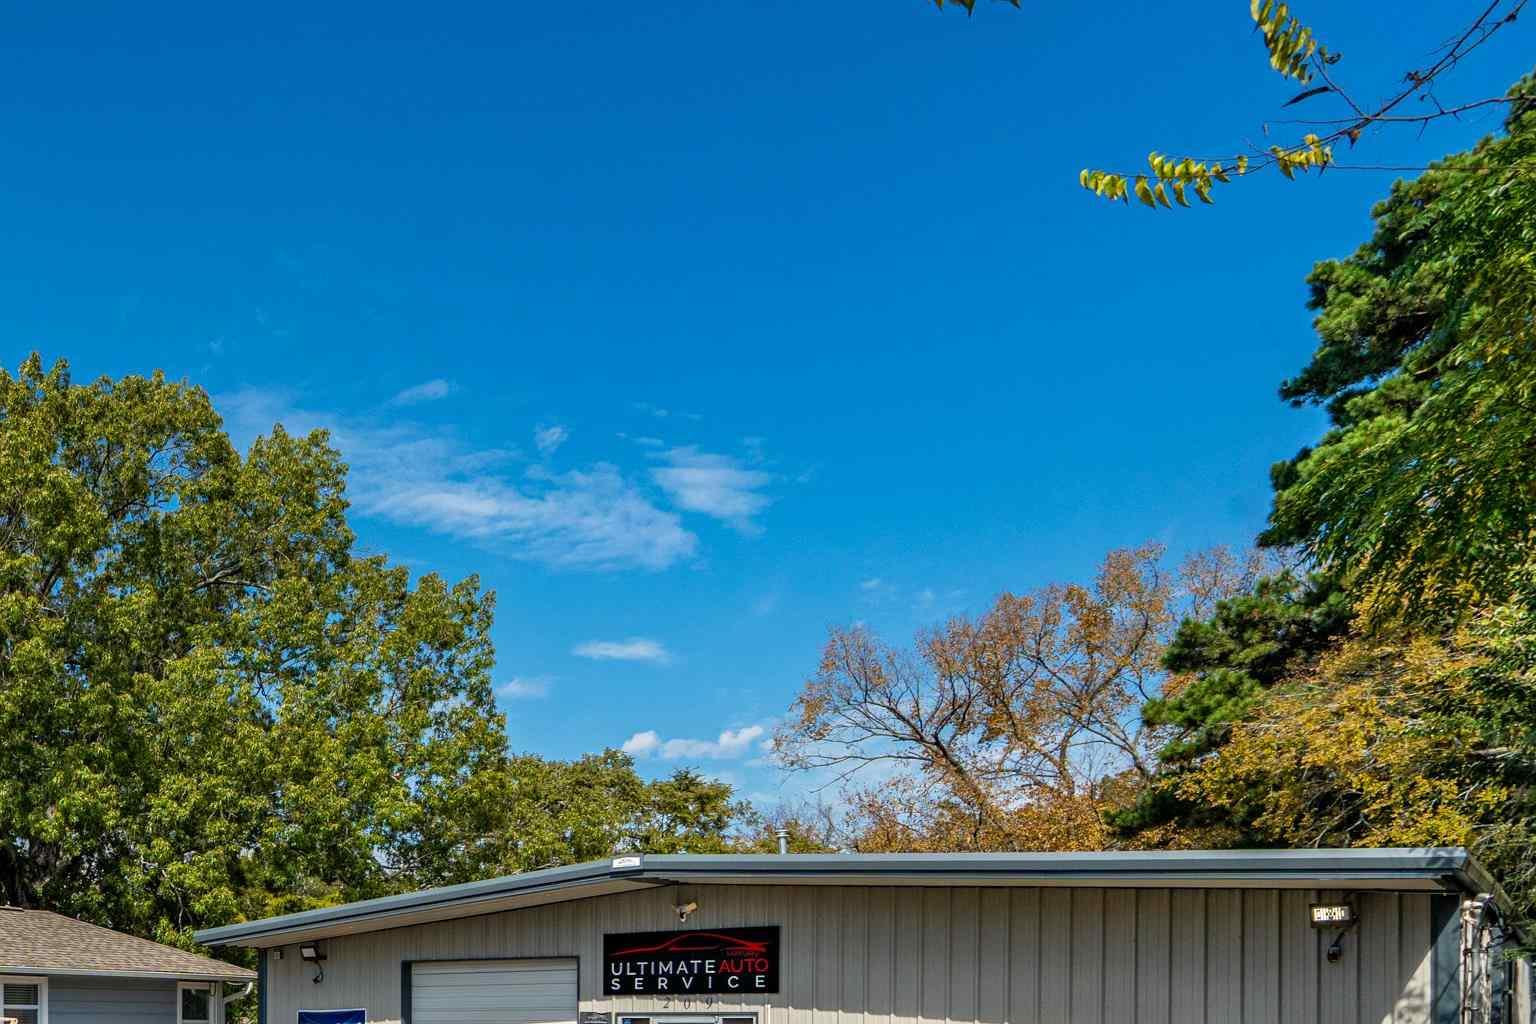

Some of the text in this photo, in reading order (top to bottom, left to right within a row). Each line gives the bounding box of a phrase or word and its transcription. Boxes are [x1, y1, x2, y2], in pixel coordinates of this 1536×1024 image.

[611, 958, 769, 976] ULTIMATE AUTO
[611, 975, 766, 990] SERVICE
